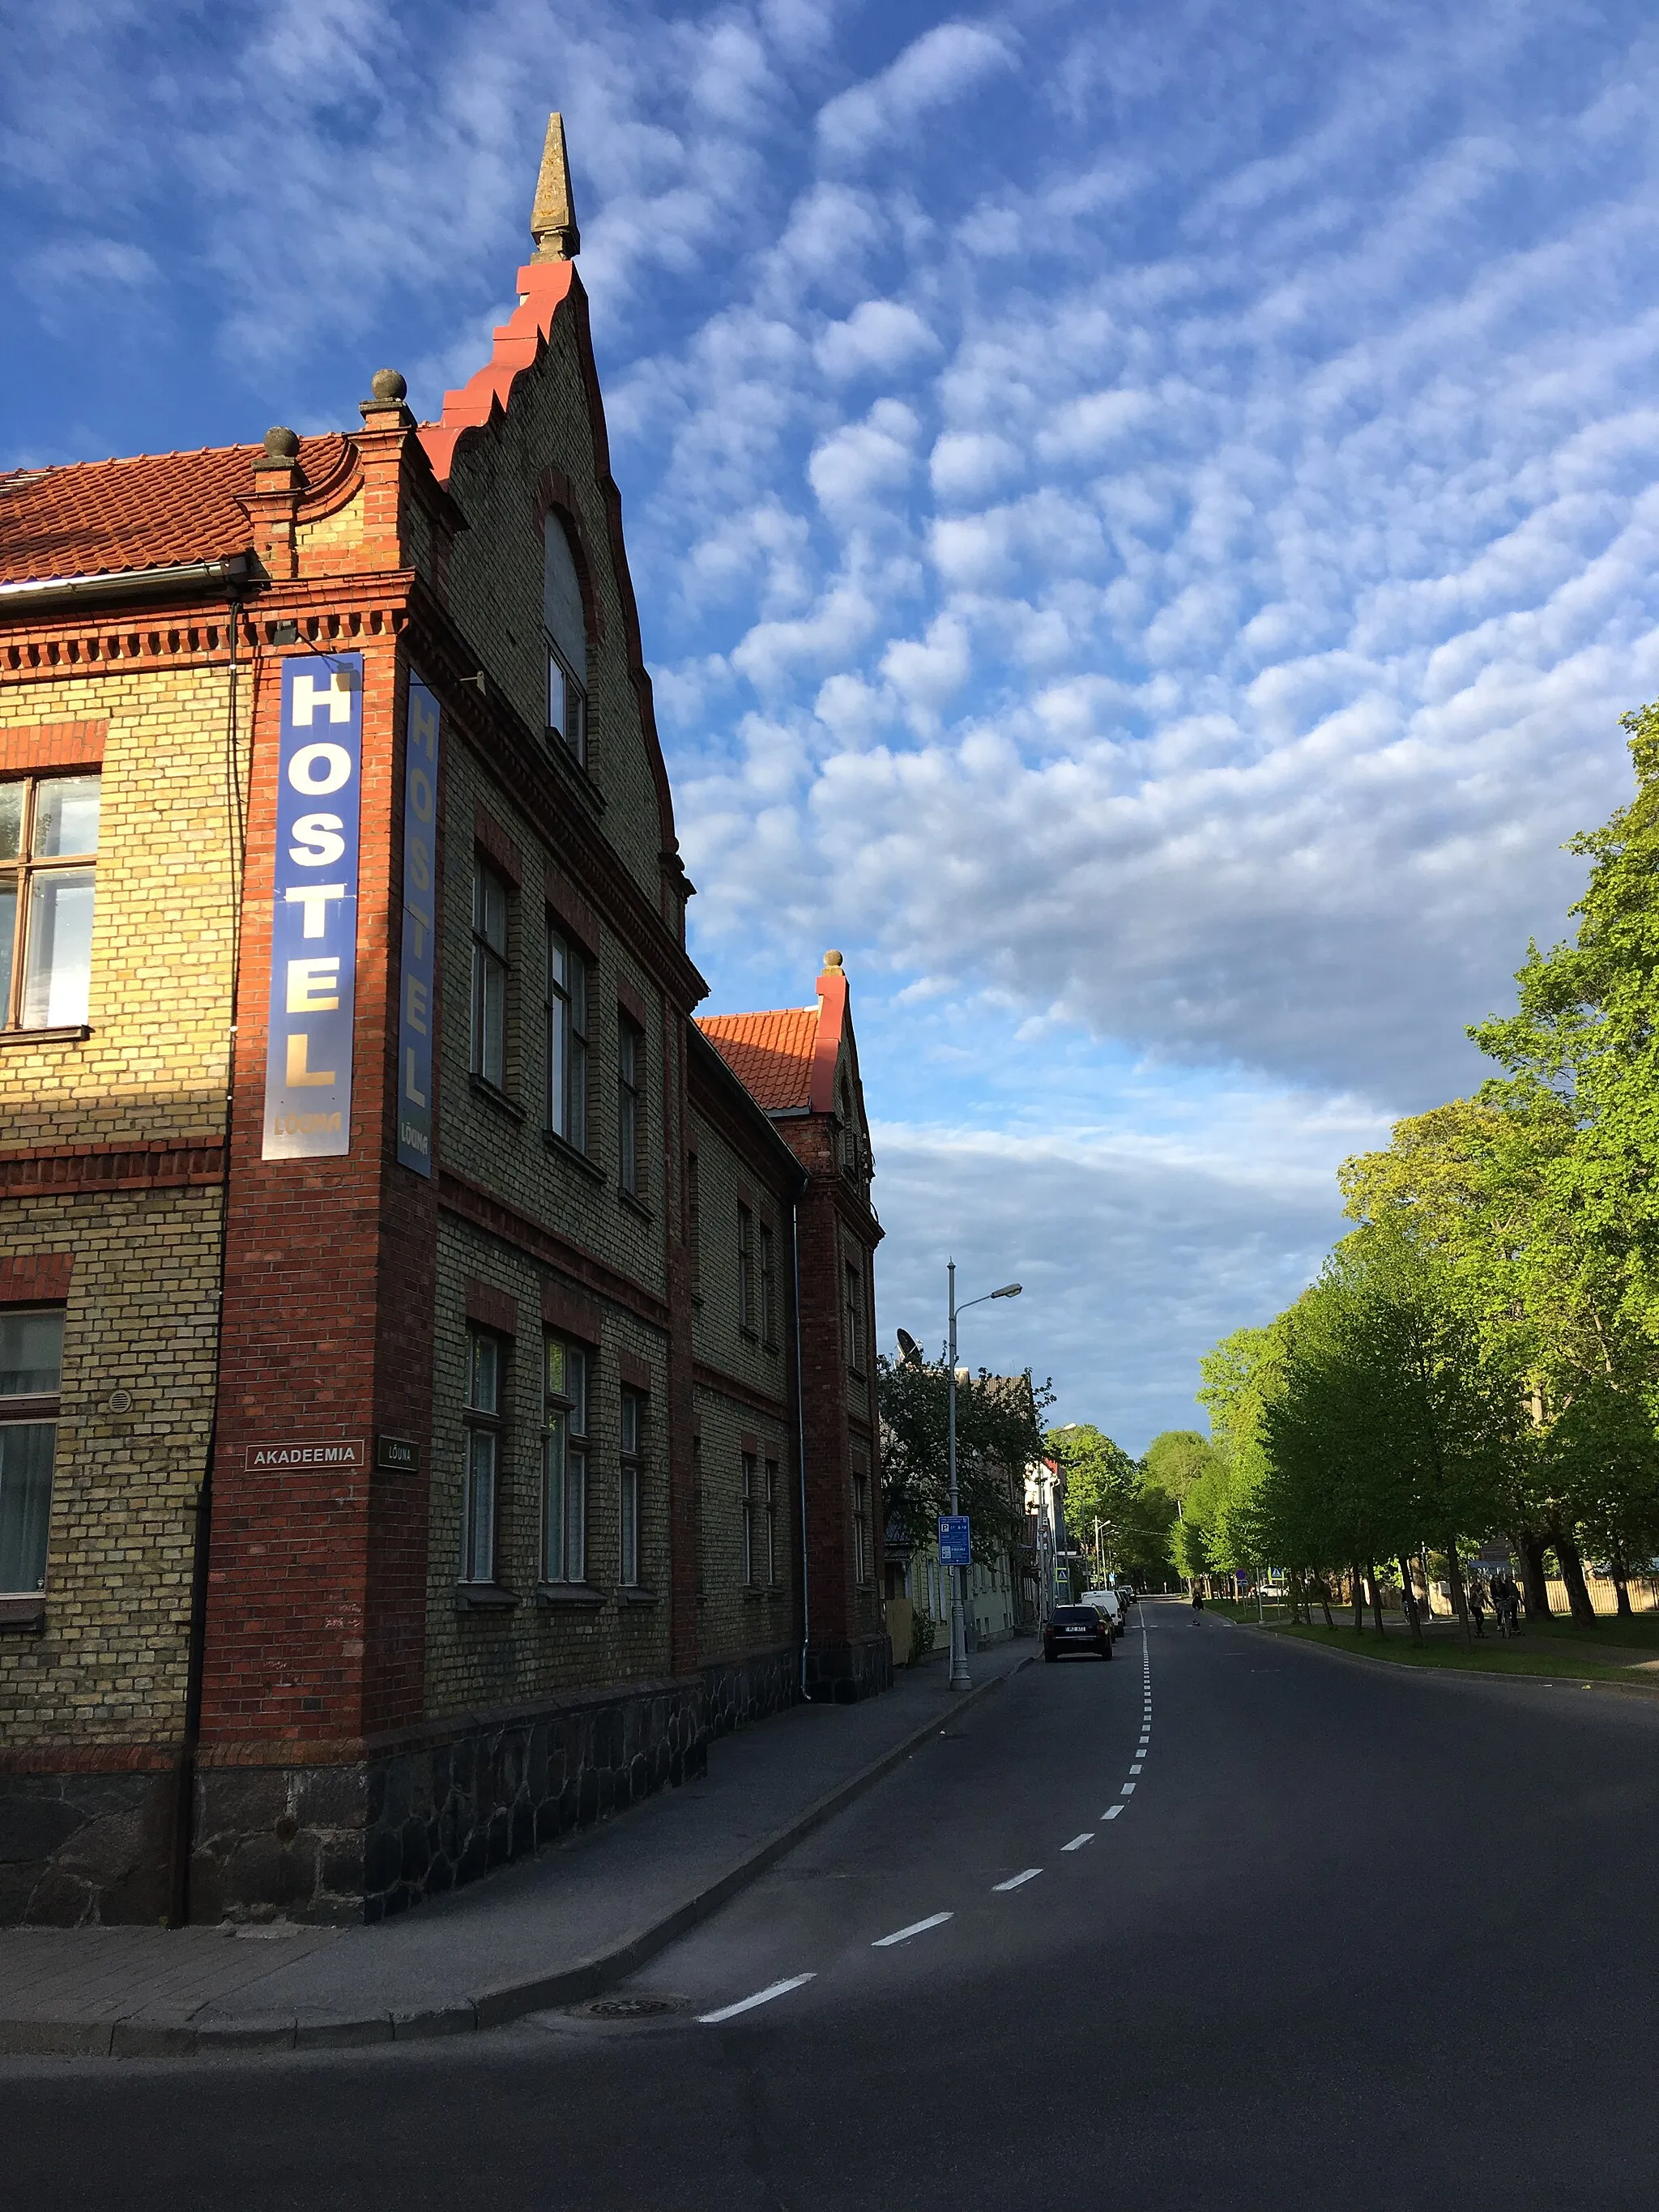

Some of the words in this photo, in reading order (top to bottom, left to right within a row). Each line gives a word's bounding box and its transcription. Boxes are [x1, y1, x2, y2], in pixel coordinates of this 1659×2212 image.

[285, 673, 352, 1086] HOSTEL
[406, 693, 435, 1108] HOSTEL
[254, 1447, 355, 1465] AKADEEMIA
[389, 1443, 411, 1462] LÕUNA
